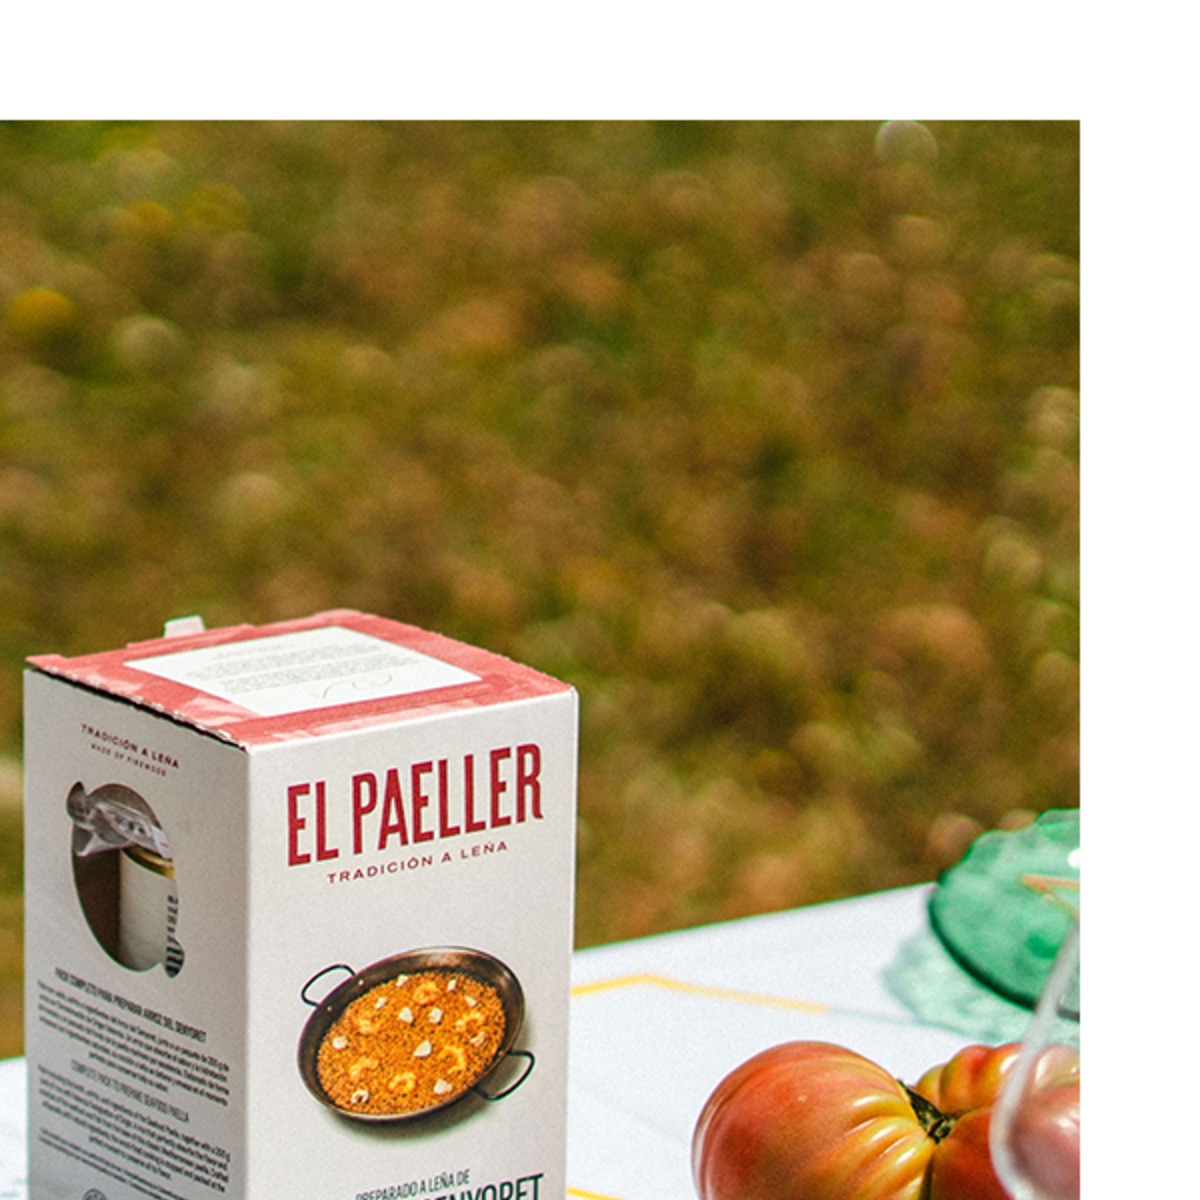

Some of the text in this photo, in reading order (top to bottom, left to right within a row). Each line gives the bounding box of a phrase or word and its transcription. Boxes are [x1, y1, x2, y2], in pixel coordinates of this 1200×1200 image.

[81, 723, 179, 769] TRADICIÓN A LEÑA
[287, 743, 544, 867] EL PAELLER
[328, 840, 508, 884] TRADICIÓN A LEÑA
[419, 1179, 427, 1194] A
[428, 1171, 455, 1193] LEÑA
[456, 1168, 470, 1187] DE
